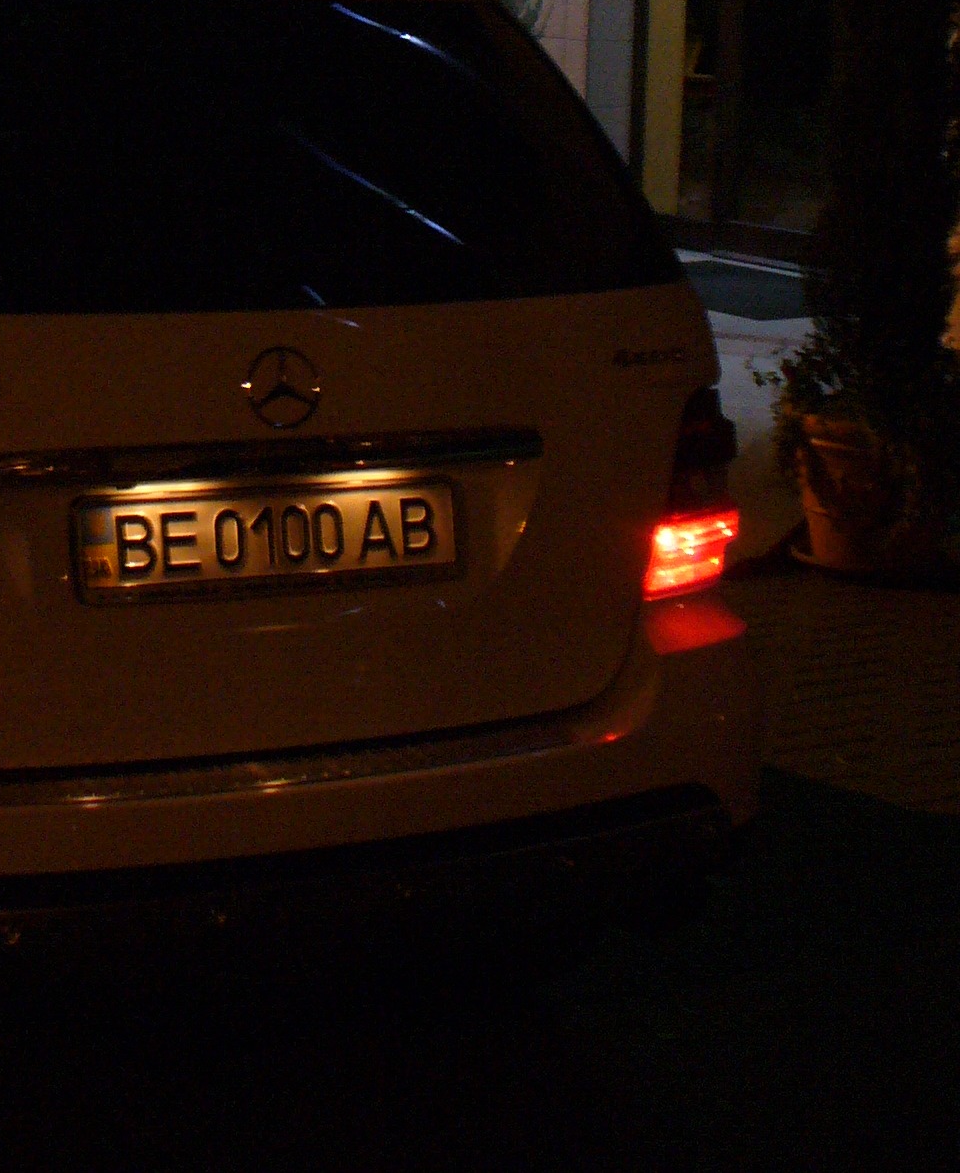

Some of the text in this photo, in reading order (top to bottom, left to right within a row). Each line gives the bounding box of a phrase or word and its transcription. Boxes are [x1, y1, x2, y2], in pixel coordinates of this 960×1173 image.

[115, 497, 437, 578] BE 0100 AB
